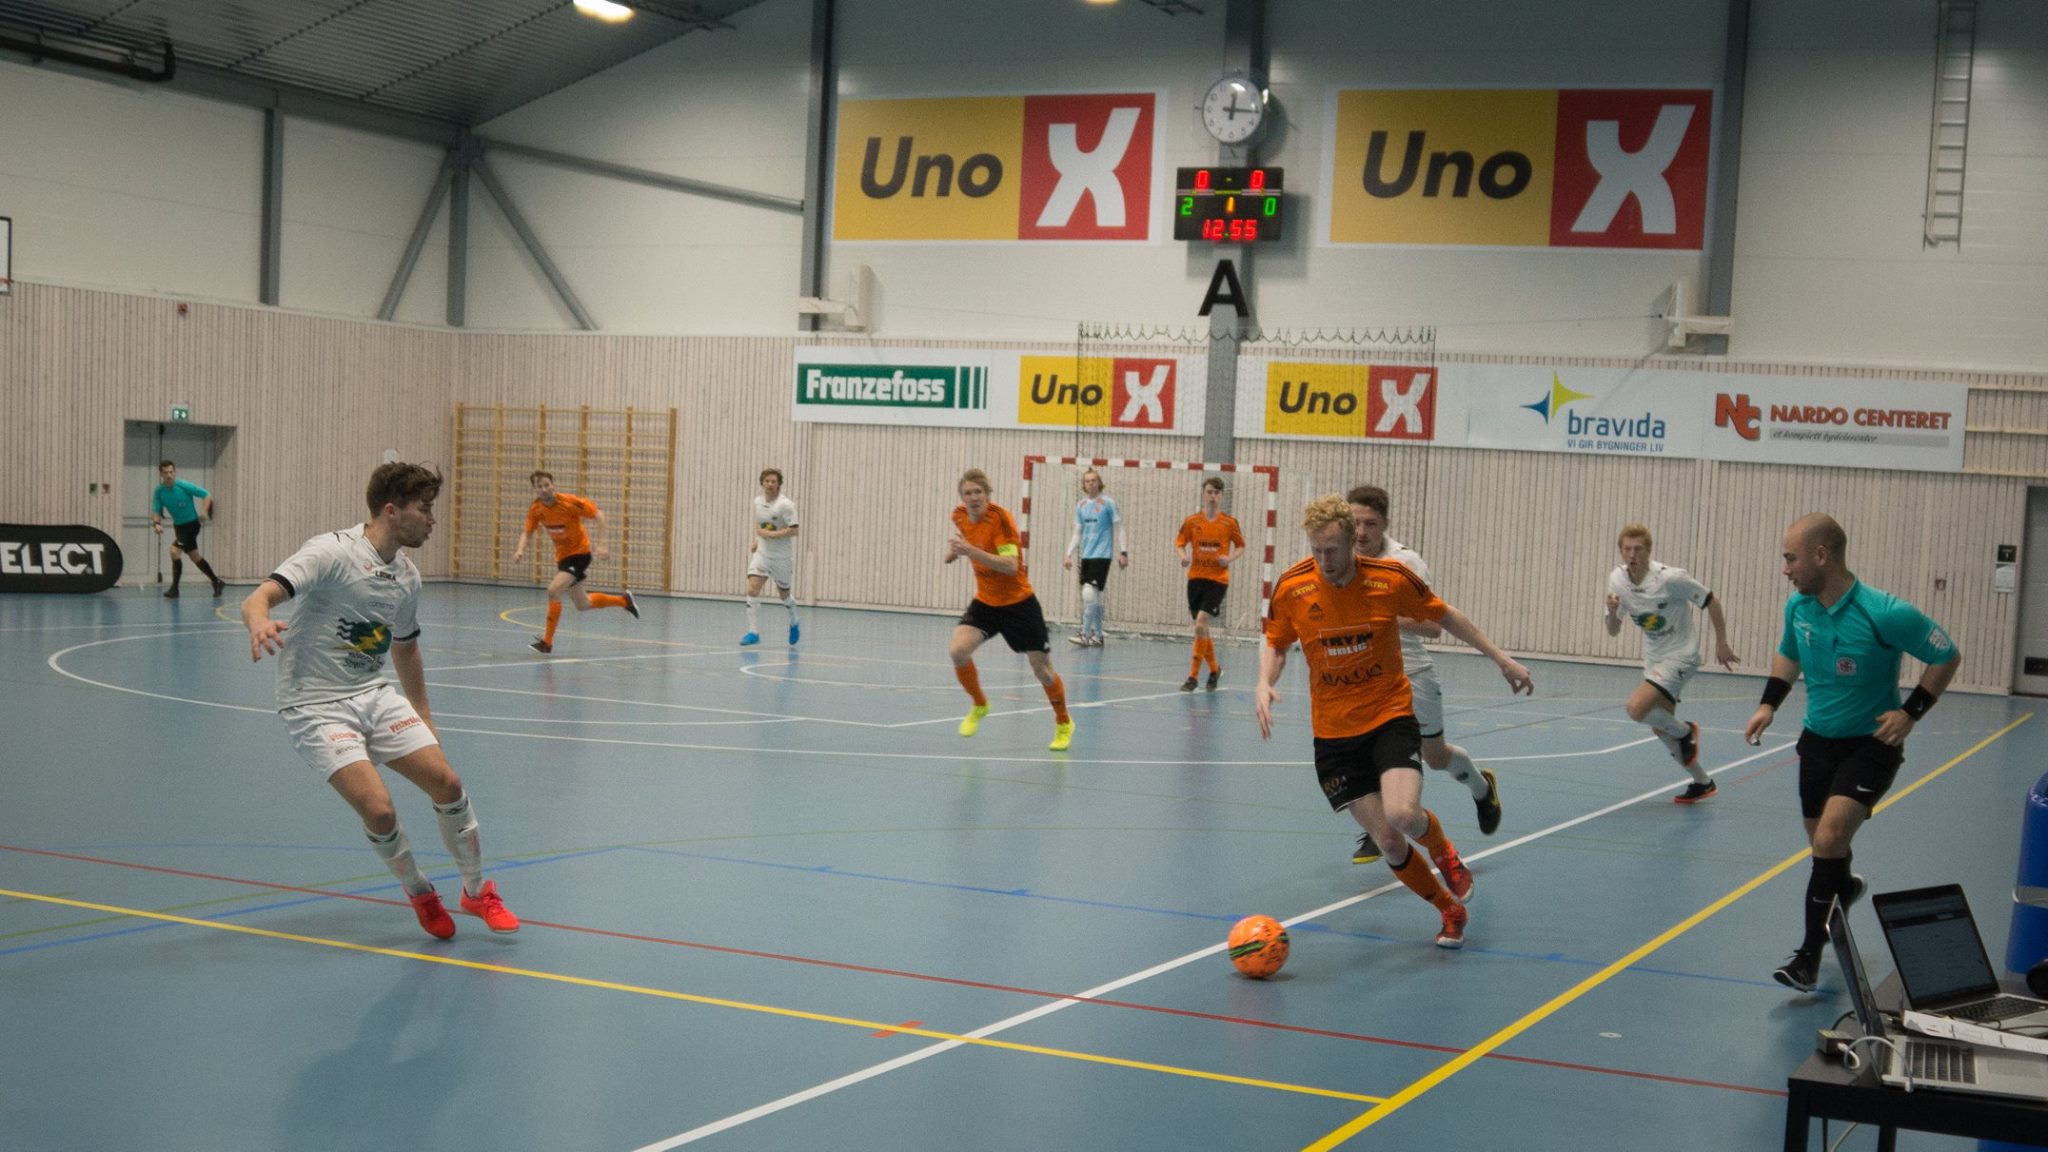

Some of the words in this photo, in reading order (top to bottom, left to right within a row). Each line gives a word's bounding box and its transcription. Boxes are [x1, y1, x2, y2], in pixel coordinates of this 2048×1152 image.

[861, 136, 1004, 199] Uno
[1035, 107, 1142, 227] X
[1195, 170, 1210, 189] 0
[1250, 170, 1265, 190] 0
[1363, 130, 1533, 199] Uno
[1570, 104, 1696, 234] X
[1180, 196, 1193, 216] 2
[1226, 197, 1235, 214] 1
[1264, 197, 1277, 216] 0
[1198, 259, 1249, 317] A
[806, 369, 945, 402] Franzefoss
[1031, 374, 1103, 406] Uno
[1119, 364, 1171, 423] X
[1279, 381, 1357, 416] Uno
[1374, 373, 1431, 433] X
[1770, 404, 1848, 426] NARDO
[1853, 408, 1952, 430] CENTERET
[1568, 409, 1665, 439] bravida
[1567, 440, 1576, 448] VI
[1578, 440, 1593, 449] GIR
[1597, 440, 1647, 451] BYGNINGER
[1650, 443, 1664, 452] LIV
